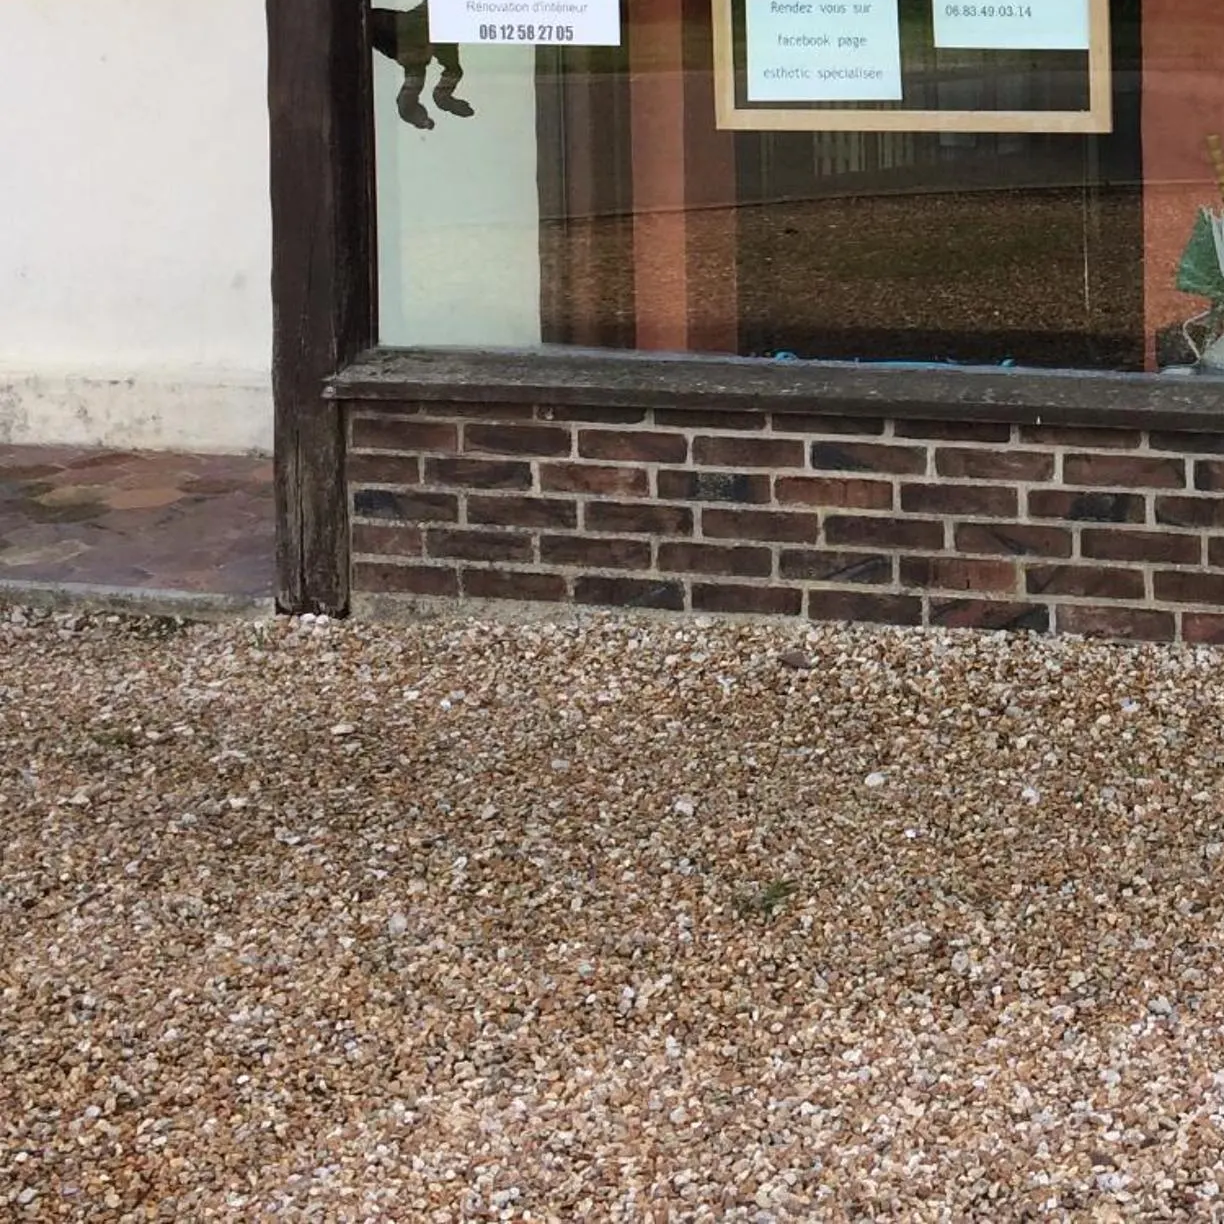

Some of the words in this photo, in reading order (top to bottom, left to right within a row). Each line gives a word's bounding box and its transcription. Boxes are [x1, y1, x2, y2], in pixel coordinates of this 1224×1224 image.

[770, 1, 813, 14] Rendez
[820, 3, 847, 14] vous
[853, 3, 873, 14] sur
[945, 4, 1033, 17] 06.83.49.03.14
[479, 24, 497, 40] 06
[500, 25, 514, 40] 12
[517, 25, 535, 40] 58
[538, 25, 554, 41] 27
[556, 25, 574, 41] 05
[777, 35, 831, 47] facebook
[838, 36, 868, 48] page
